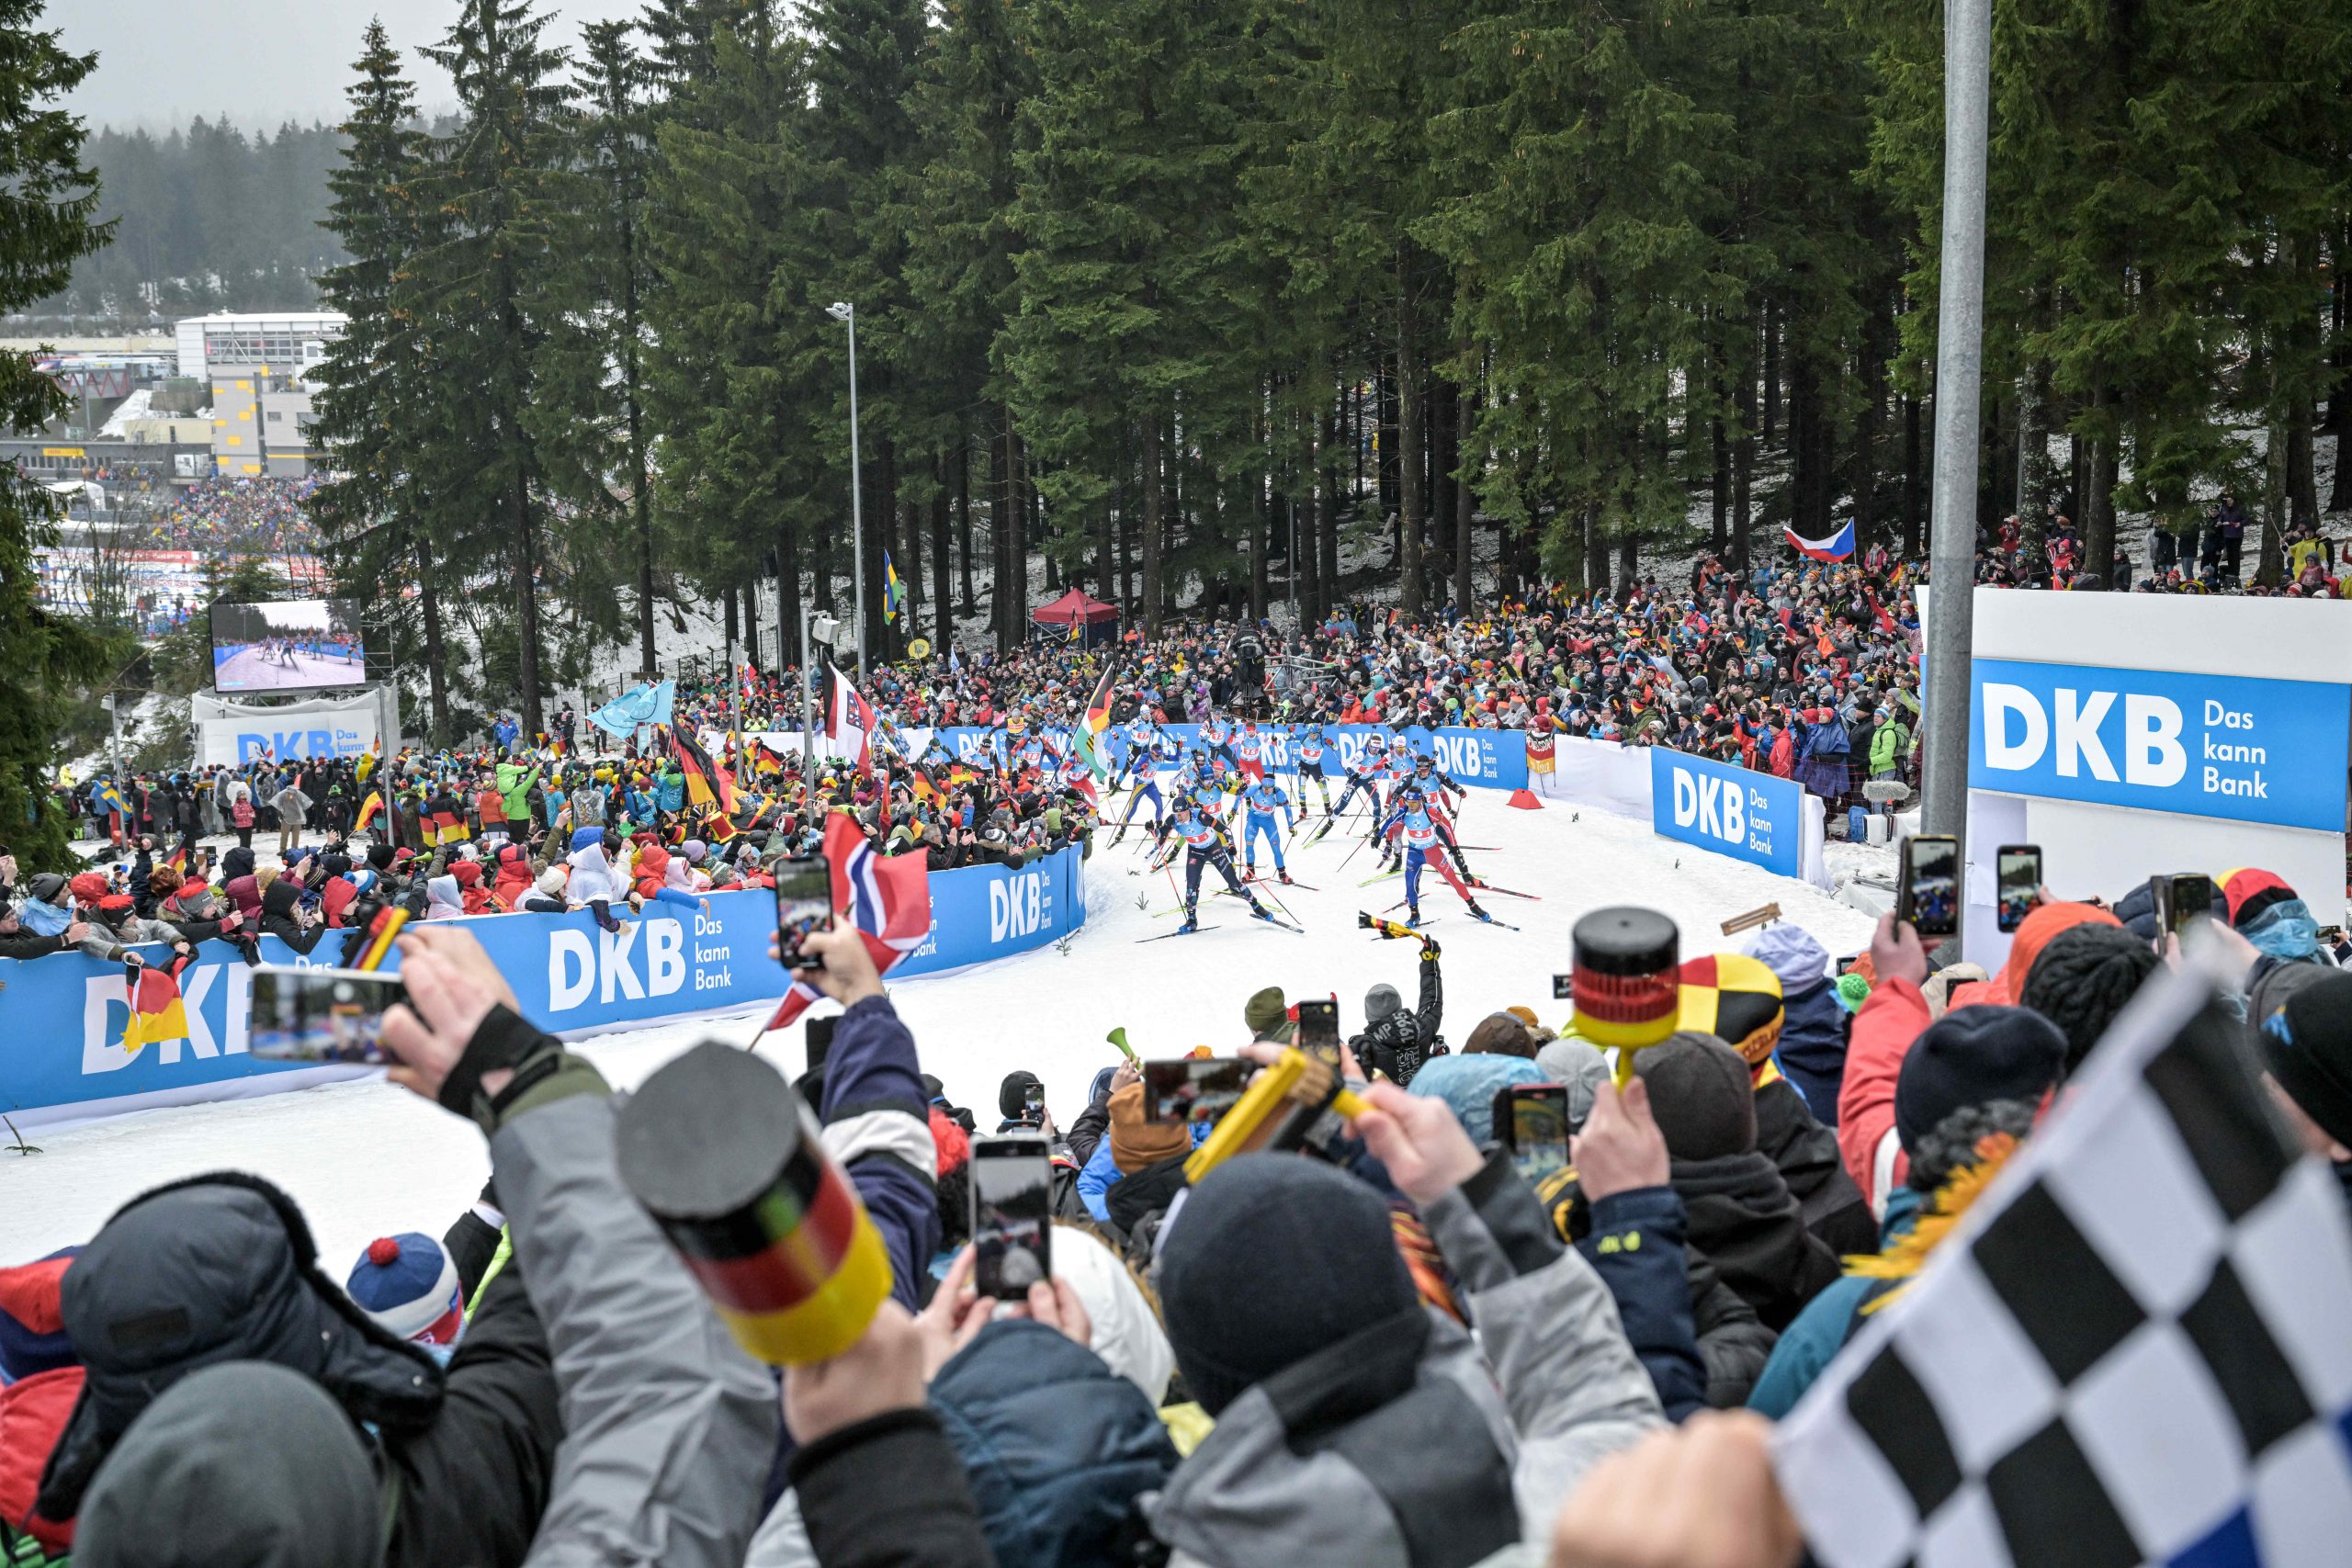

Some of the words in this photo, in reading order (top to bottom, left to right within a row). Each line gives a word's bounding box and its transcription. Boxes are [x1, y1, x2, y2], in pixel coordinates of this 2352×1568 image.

[2205, 700, 2254, 729] Das
[336, 729, 357, 739] Das
[1482, 740, 1493, 750] Das
[1983, 682, 2187, 787] DKB
[237, 730, 335, 765] DKB
[337, 741, 365, 751] kann
[1433, 735, 1481, 777] DKB
[2205, 732, 2266, 764] kann
[1483, 755, 1497, 764] kann
[1484, 768, 1498, 778] Bank
[2204, 766, 2268, 798] Bank
[1208, 805, 1216, 814] 4
[1674, 766, 1745, 844] DKB
[1750, 787, 1768, 809] Das
[1750, 810, 1771, 833] kann
[1750, 832, 1772, 855] Bank
[1041, 870, 1050, 888] Das
[989, 873, 1040, 943] DKB
[695, 915, 723, 936] Das
[1041, 910, 1052, 930] Bank
[695, 942, 730, 964] kann
[548, 918, 686, 1012] DKB
[695, 964, 732, 991] Bank
[1374, 1022, 1392, 1042] MP
[1392, 1011, 1415, 1044] 1995
